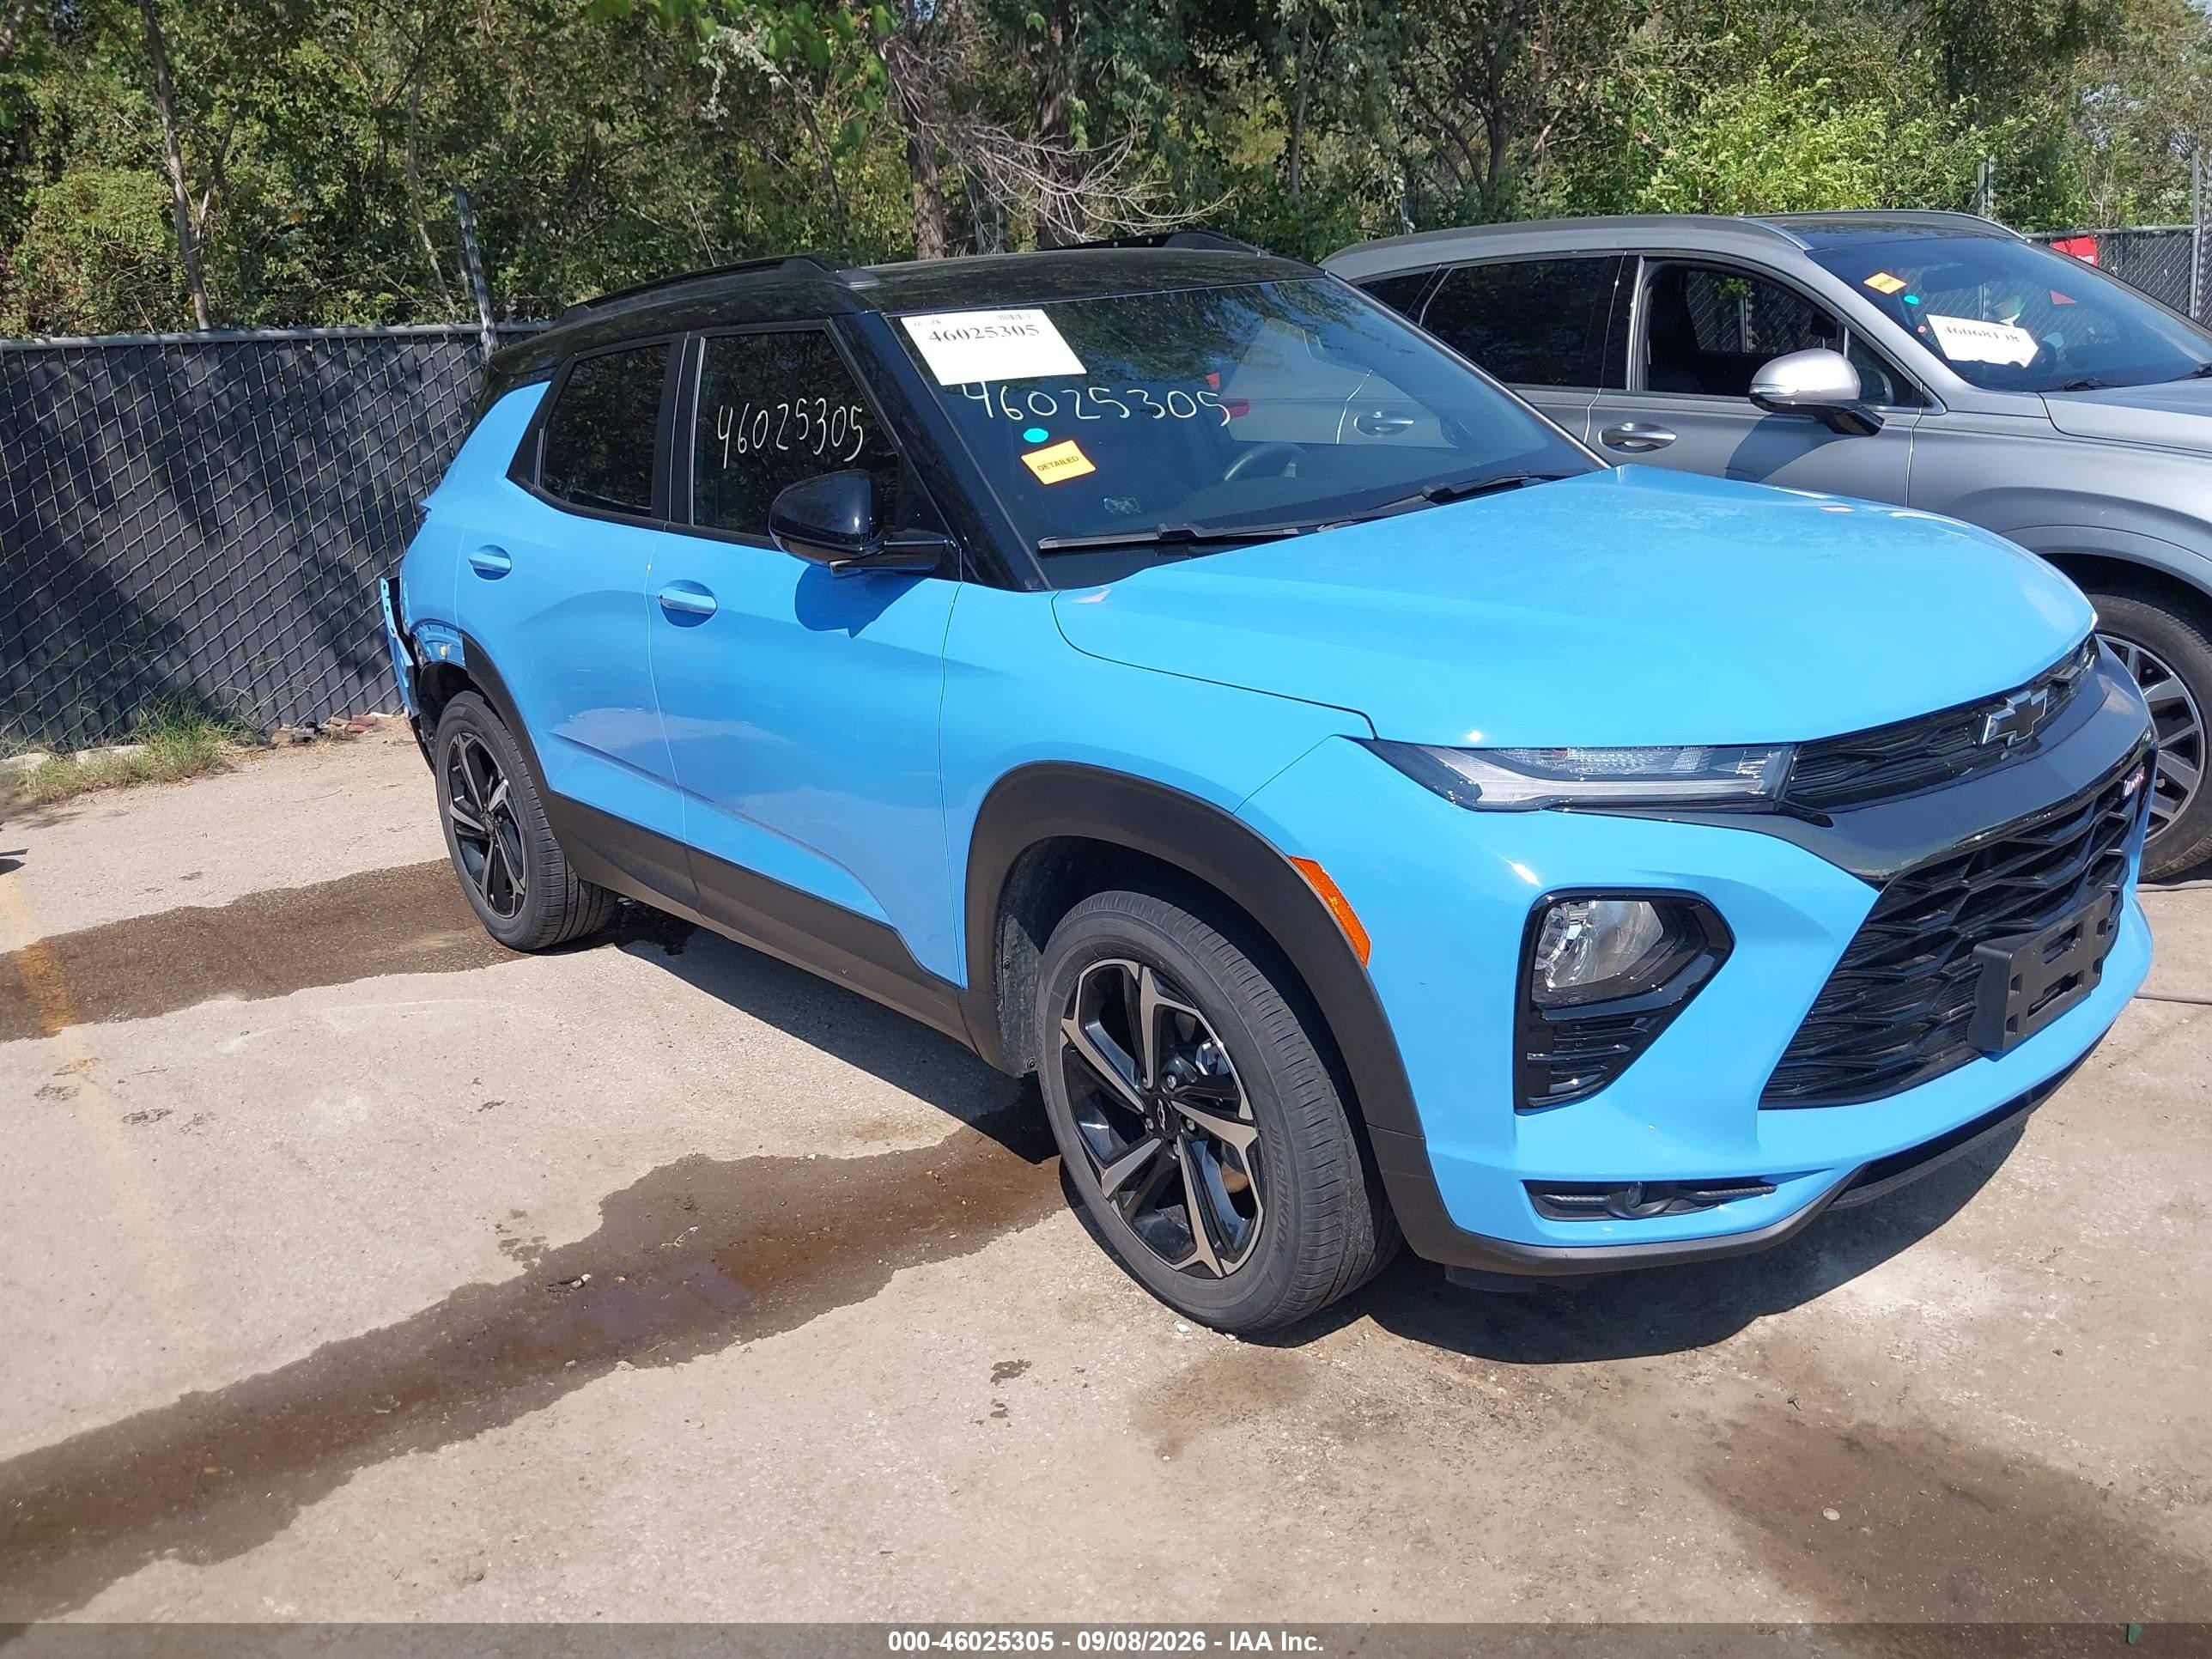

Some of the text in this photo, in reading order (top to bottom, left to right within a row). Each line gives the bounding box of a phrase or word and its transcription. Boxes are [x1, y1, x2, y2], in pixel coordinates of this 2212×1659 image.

[928, 324, 1040, 343] 46025305
[962, 381, 1231, 427] 46025305
[717, 397, 864, 470] 46025305
[1036, 455, 1079, 471] DETAILED
